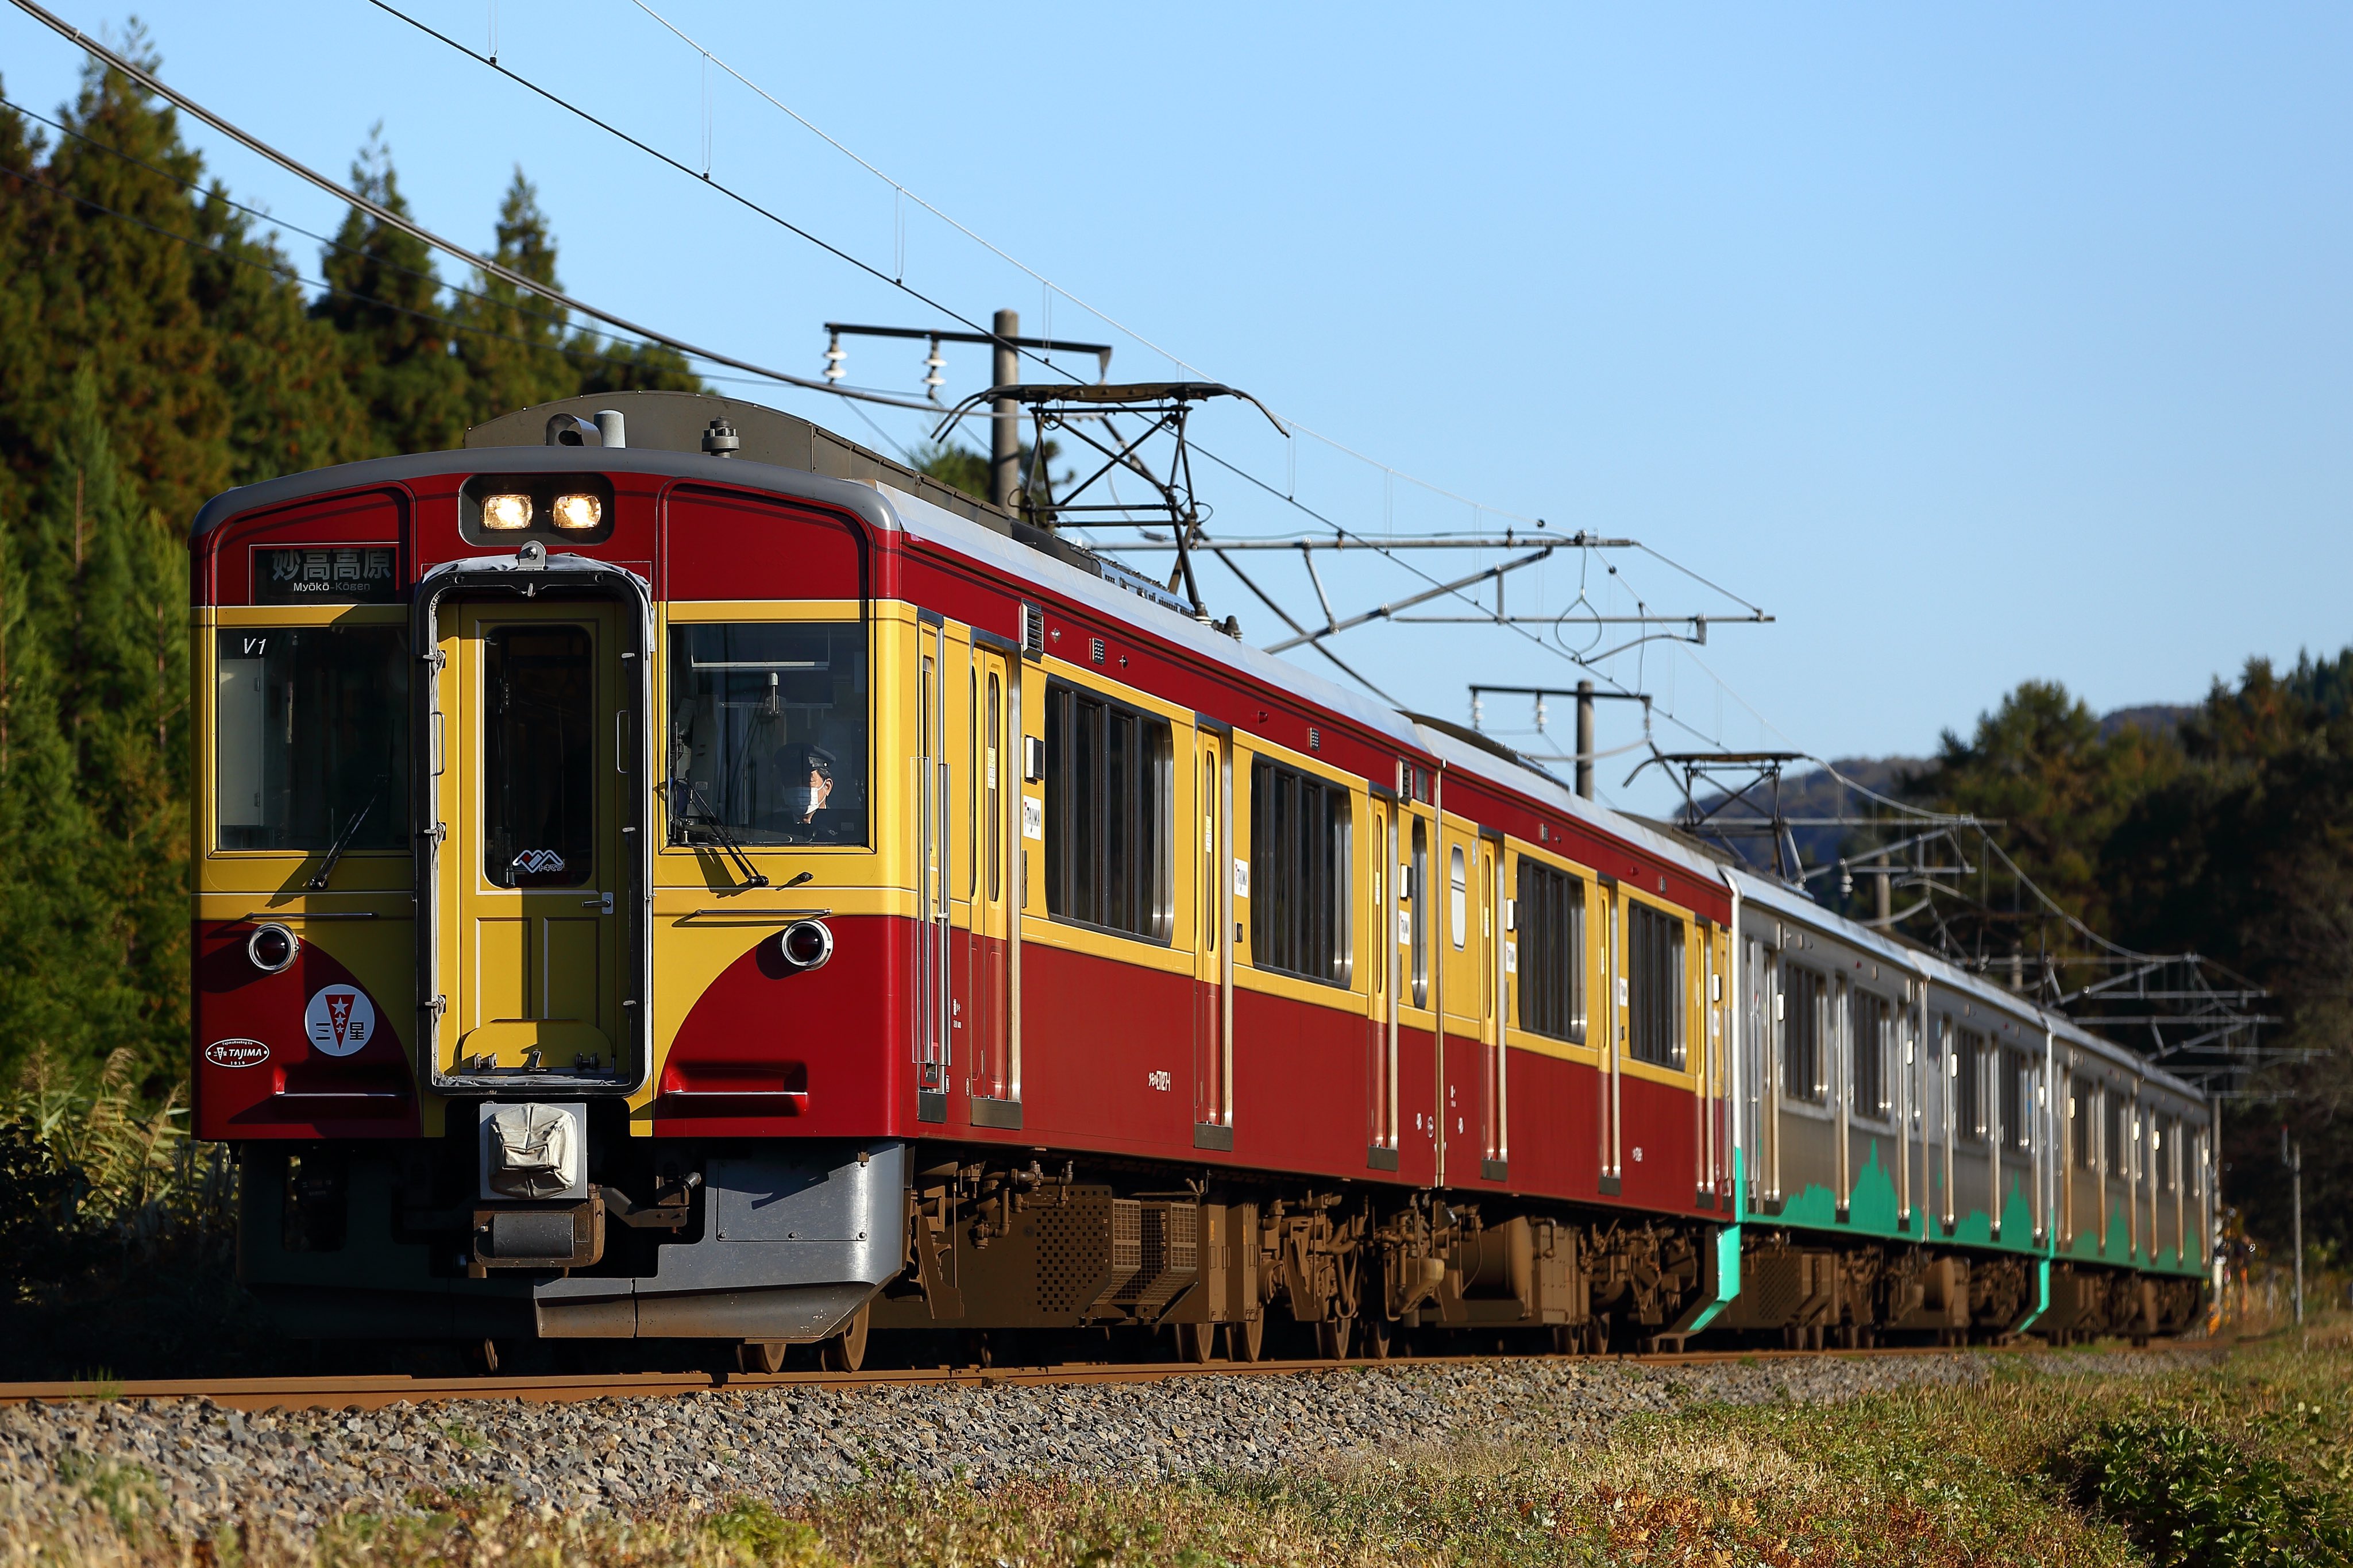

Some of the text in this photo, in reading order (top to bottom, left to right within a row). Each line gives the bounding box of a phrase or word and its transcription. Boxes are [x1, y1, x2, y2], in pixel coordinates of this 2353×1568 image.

[272, 549, 391, 580] 妙高高原
[294, 582, 370, 592] Myōkō-Kōgen
[244, 638, 267, 655] V1
[229, 1049, 261, 1059] TAJIMA
